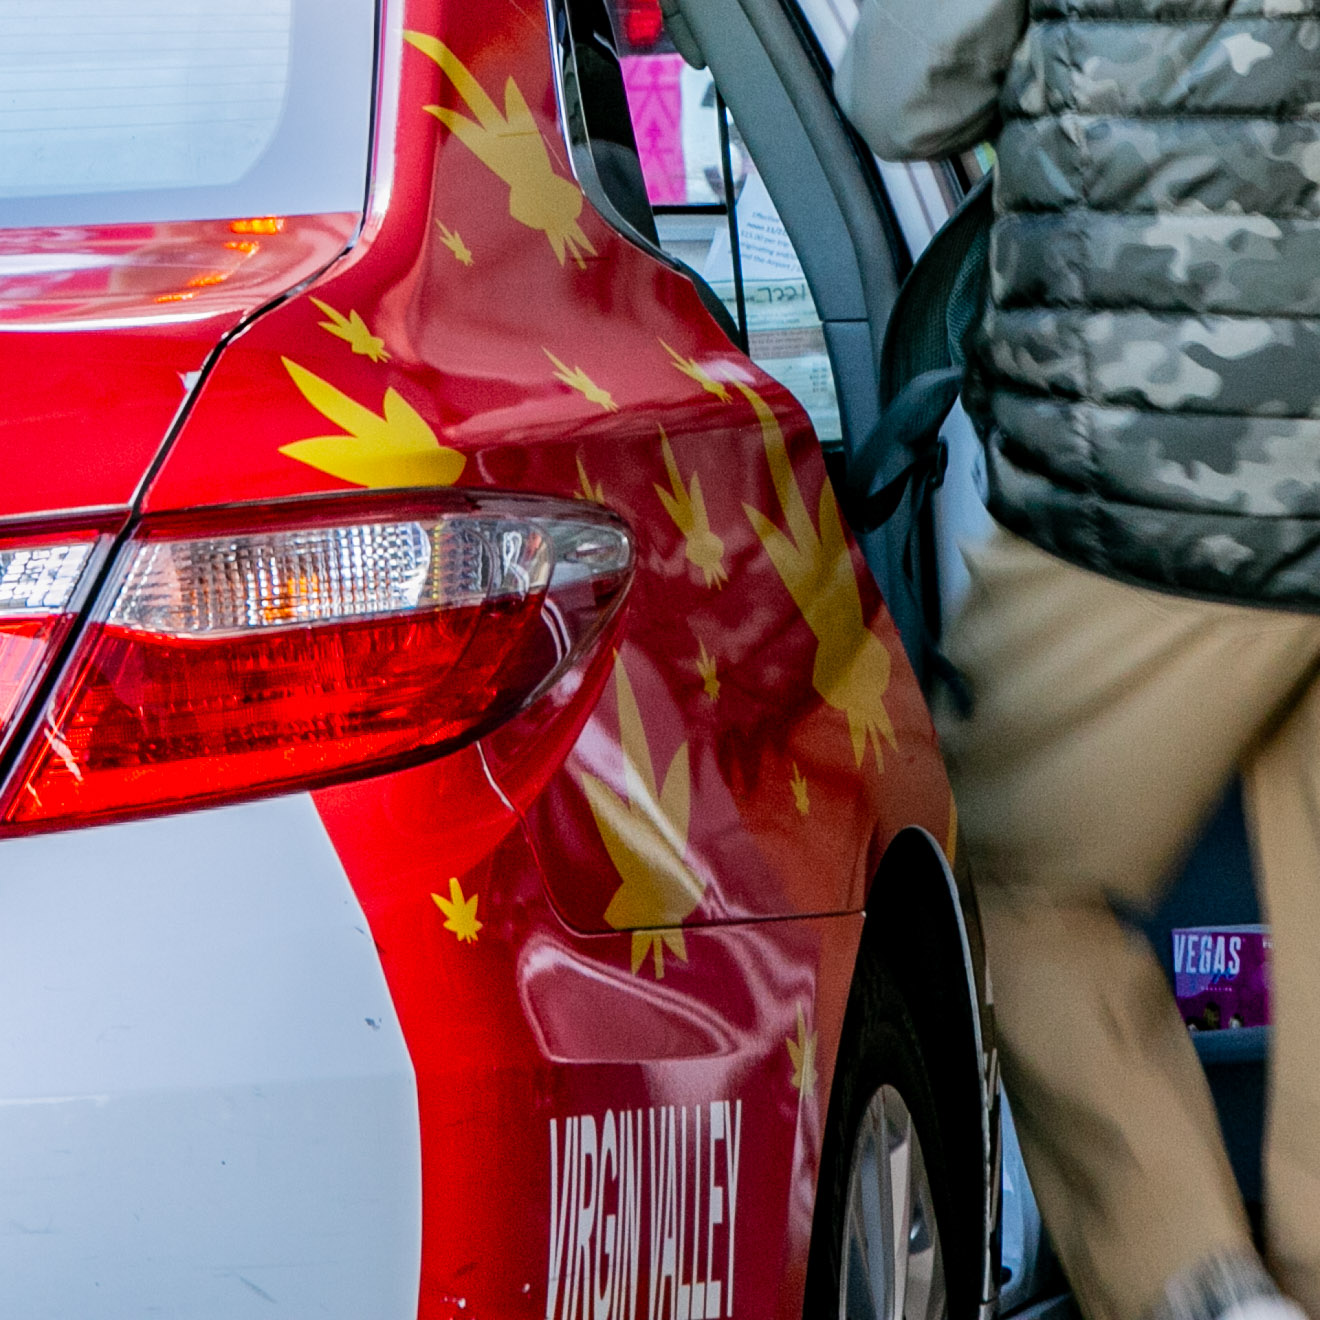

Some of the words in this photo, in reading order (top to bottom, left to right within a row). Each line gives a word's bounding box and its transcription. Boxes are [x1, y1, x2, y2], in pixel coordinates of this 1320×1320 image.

[1173, 933, 1242, 976] VEGAS
[546, 1108, 643, 1320] VIRGIN
[649, 1098, 742, 1319] VALLEY
